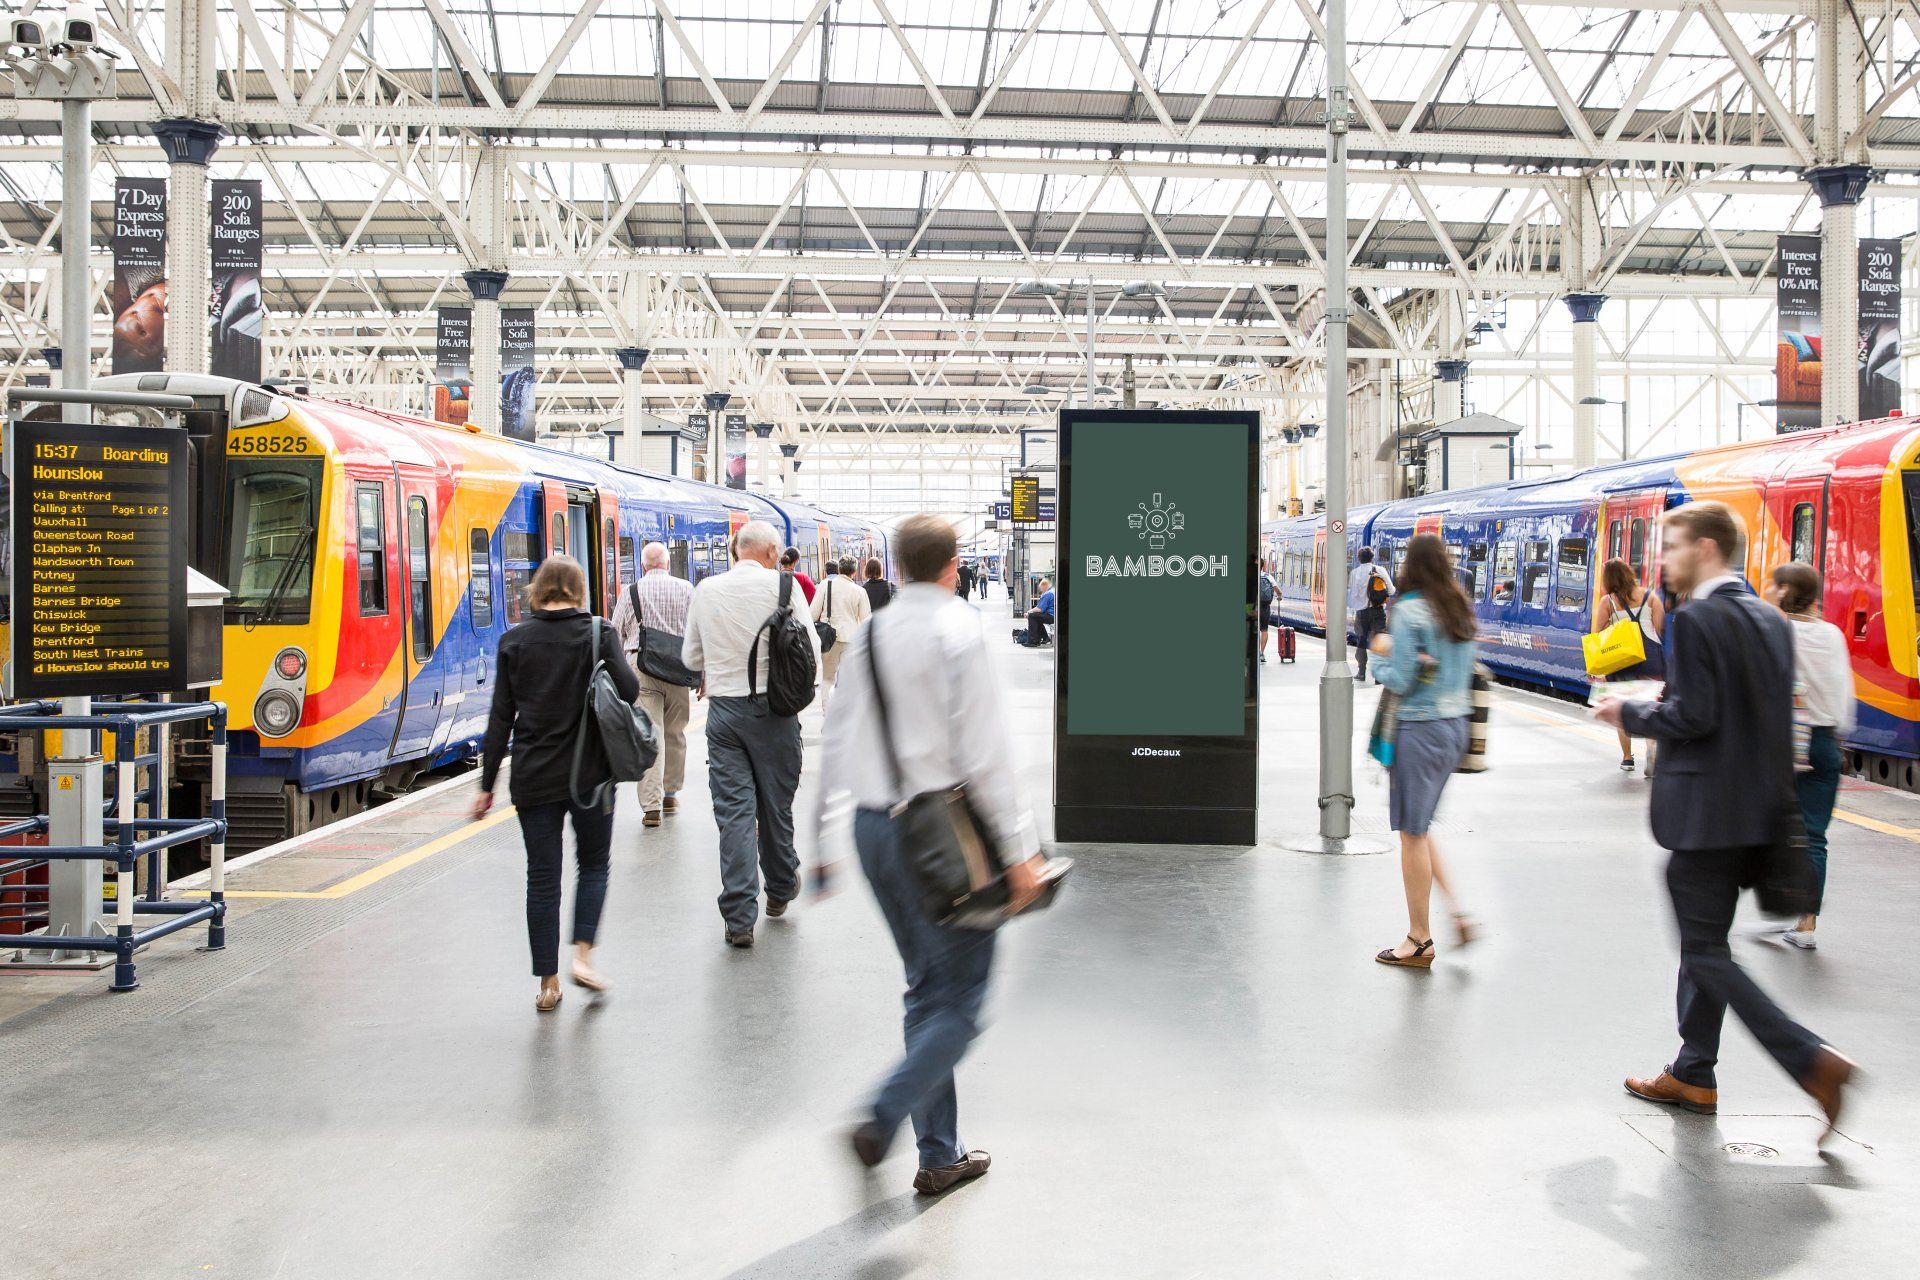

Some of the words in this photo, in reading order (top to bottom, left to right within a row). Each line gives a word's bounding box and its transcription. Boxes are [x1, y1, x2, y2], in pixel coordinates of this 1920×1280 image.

[118, 189, 129, 205] 7
[132, 189, 164, 211] Day
[223, 196, 251, 210] 200
[117, 208, 164, 226] Express
[223, 212, 251, 225] Sofa
[116, 225, 164, 242] Delivery
[214, 225, 260, 243] Ranges
[1781, 249, 1817, 261] Interest
[1868, 253, 1892, 266] 200
[1787, 263, 1812, 276] Free
[1868, 267, 1892, 280] Sofa
[1779, 278, 1796, 289] 0%
[1798, 279, 1819, 291] APR
[1861, 280, 1900, 296] Ranges
[441, 317, 468, 327] Interest
[502, 319, 534, 328] Exclusive
[444, 327, 464, 337] Free
[508, 329, 528, 339] Sofa
[438, 339, 451, 347] 0%
[452, 339, 469, 348] APR
[503, 340, 534, 351] Designs
[229, 436, 308, 453] 458525
[35, 444, 78, 459] 15:37
[103, 447, 168, 464] Boarding
[33, 466, 103, 481] Hounslow
[33, 491, 54, 500] via
[59, 491, 111, 501] Brentford
[33, 503, 67, 515] Calling
[71, 504, 86, 513] at:
[112, 505, 136, 516] Page
[138, 506, 145, 515] 1
[147, 506, 159, 515] of
[162, 507, 169, 515] 2
[996, 505, 1010, 517] 15
[33, 517, 88, 527] Vauxhall
[33, 531, 102, 541] Queenstown
[107, 531, 134, 541] Road
[33, 544, 81, 554] Clapham
[87, 544, 101, 554] Jn
[33, 557, 102, 567] Wandsworth
[107, 557, 134, 567] Town
[1086, 555, 1228, 577] BAMBOOH
[33, 570, 75, 582] Putney
[33, 584, 75, 593] Barnes
[33, 597, 75, 606] Barnes
[81, 596, 121, 608] Bridge
[33, 610, 86, 620] Chiswick
[33, 624, 55, 633] Kew
[61, 623, 101, 634] Bridge
[33, 636, 94, 647] Brentford
[33, 650, 68, 660] South
[73, 649, 100, 658] West
[105, 648, 143, 657] Trains
[47, 663, 103, 673] Hounslow
[107, 661, 146, 671] should
[151, 660, 169, 670] tra
[1131, 747, 1181, 757] JCDecaux
